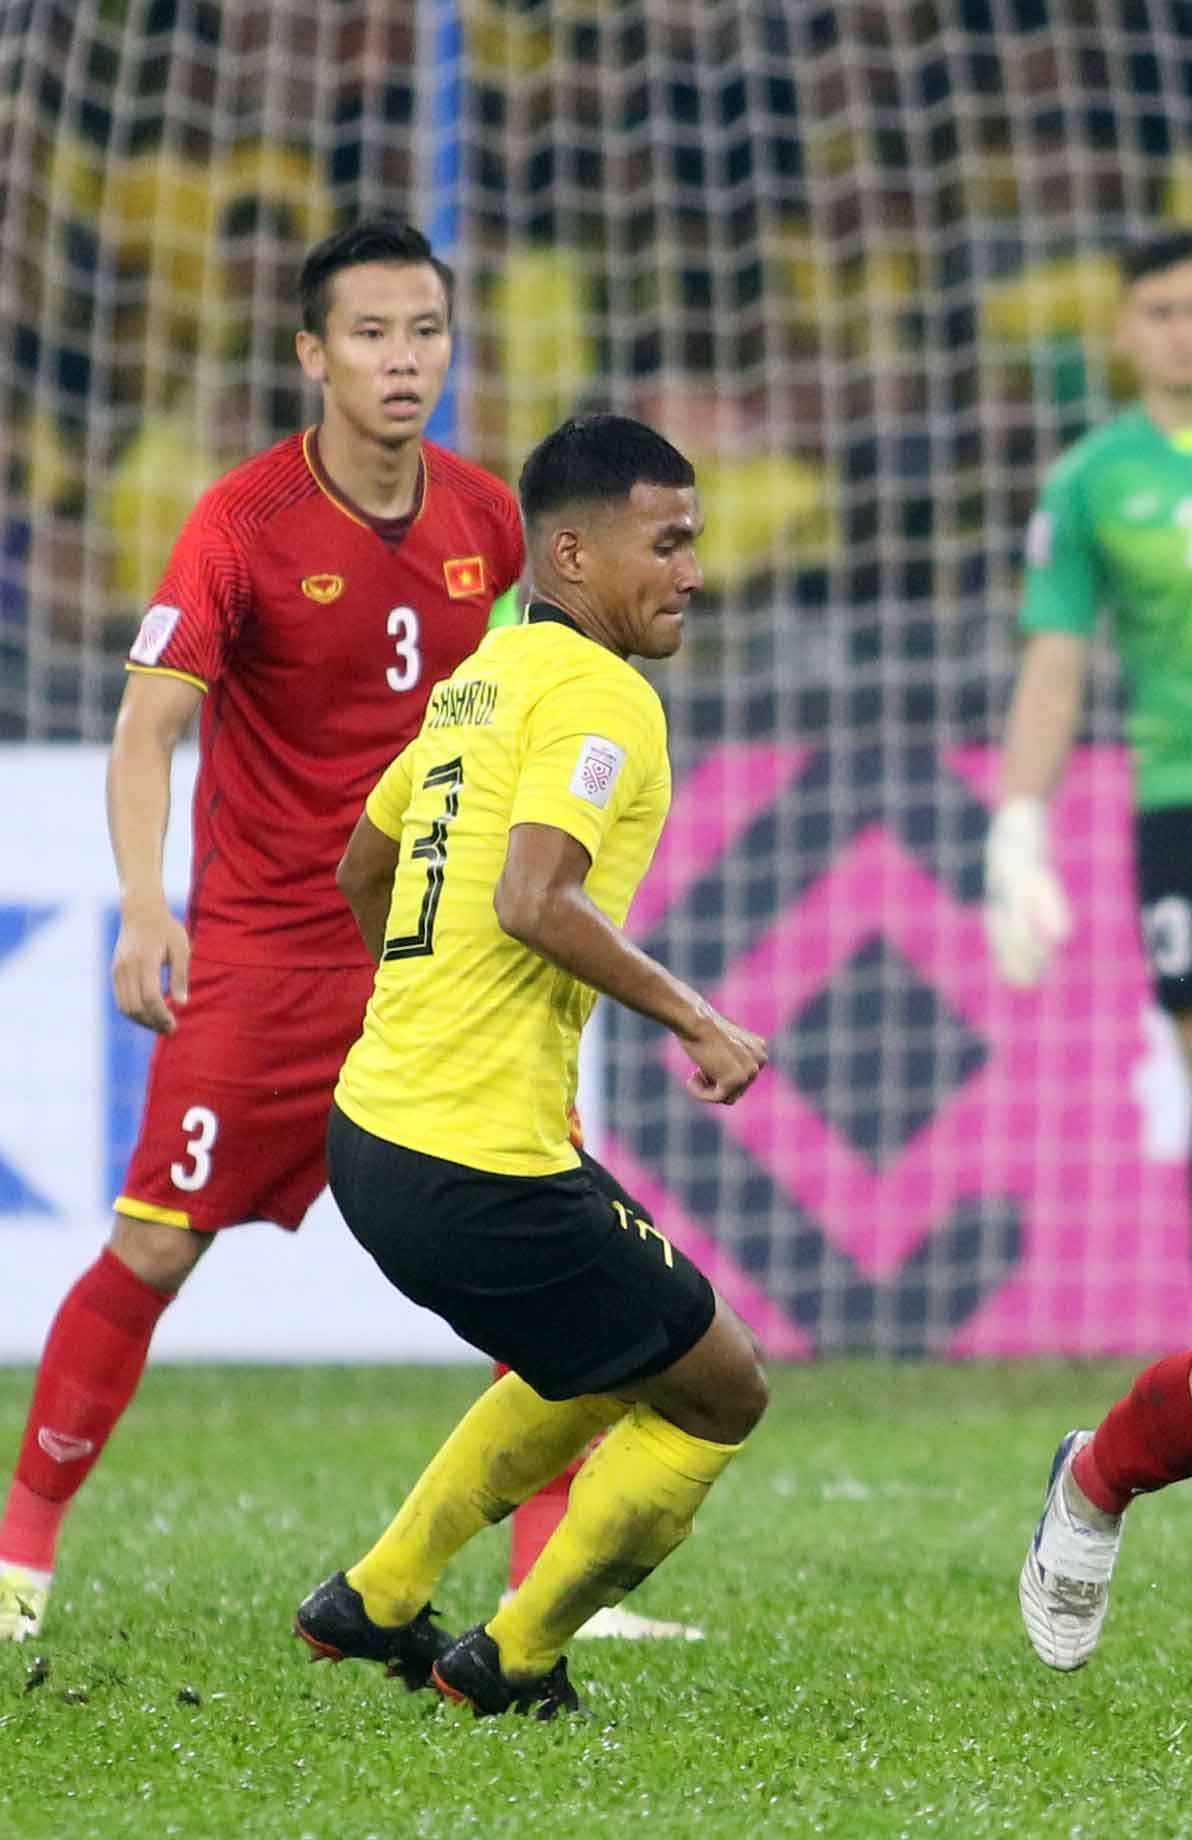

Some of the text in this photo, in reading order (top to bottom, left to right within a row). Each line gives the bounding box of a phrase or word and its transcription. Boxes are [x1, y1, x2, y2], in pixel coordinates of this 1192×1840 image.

[386, 606, 420, 692] 3
[428, 680, 498, 729] SHAHRUL
[384, 756, 464, 961] 3
[170, 1105, 217, 1192] 3
